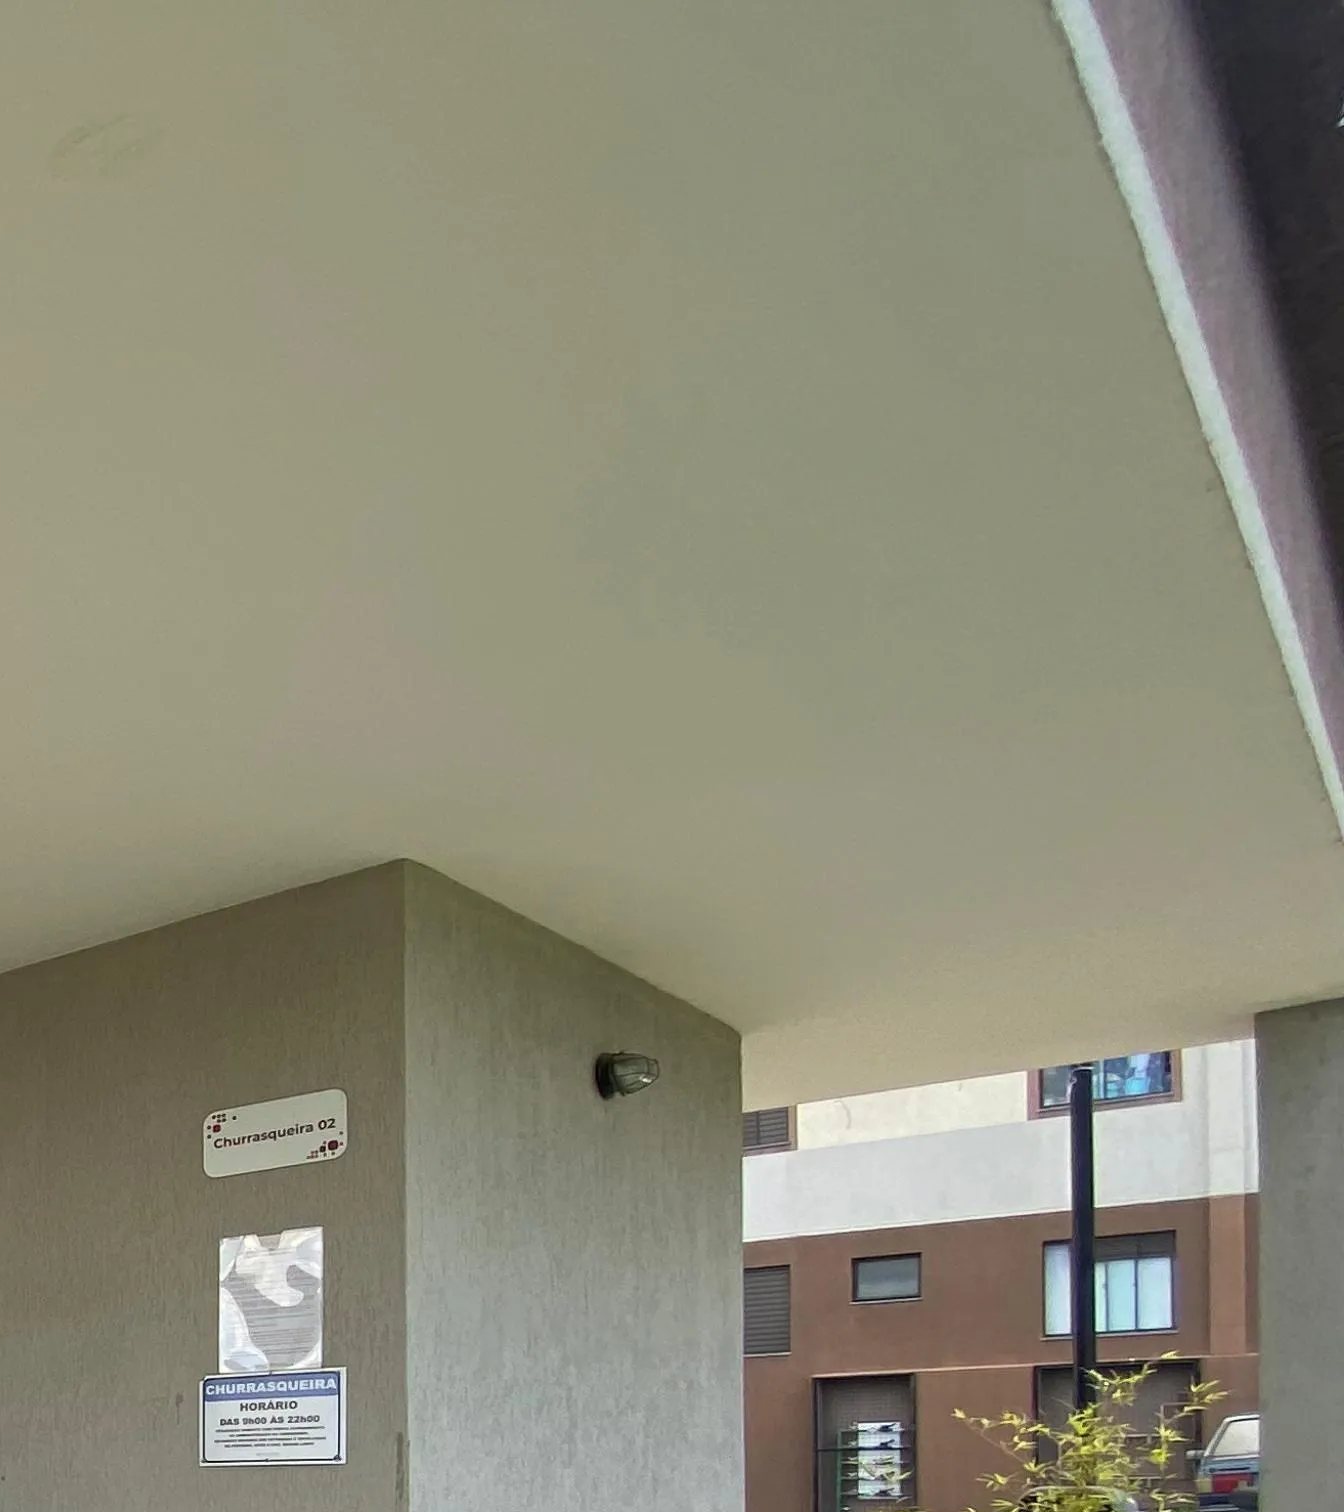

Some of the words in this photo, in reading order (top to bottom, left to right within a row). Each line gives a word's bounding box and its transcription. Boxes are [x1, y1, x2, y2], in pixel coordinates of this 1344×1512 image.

[213, 1124, 314, 1149] Churrasqueira
[318, 1118, 336, 1131] 02
[205, 1378, 337, 1395] CHURRASQUEIRA
[240, 1400, 298, 1411] HORÁRIO
[220, 1418, 239, 1426] DAS
[243, 1416, 267, 1425] 9h00
[288, 1415, 320, 1423] 22h00
